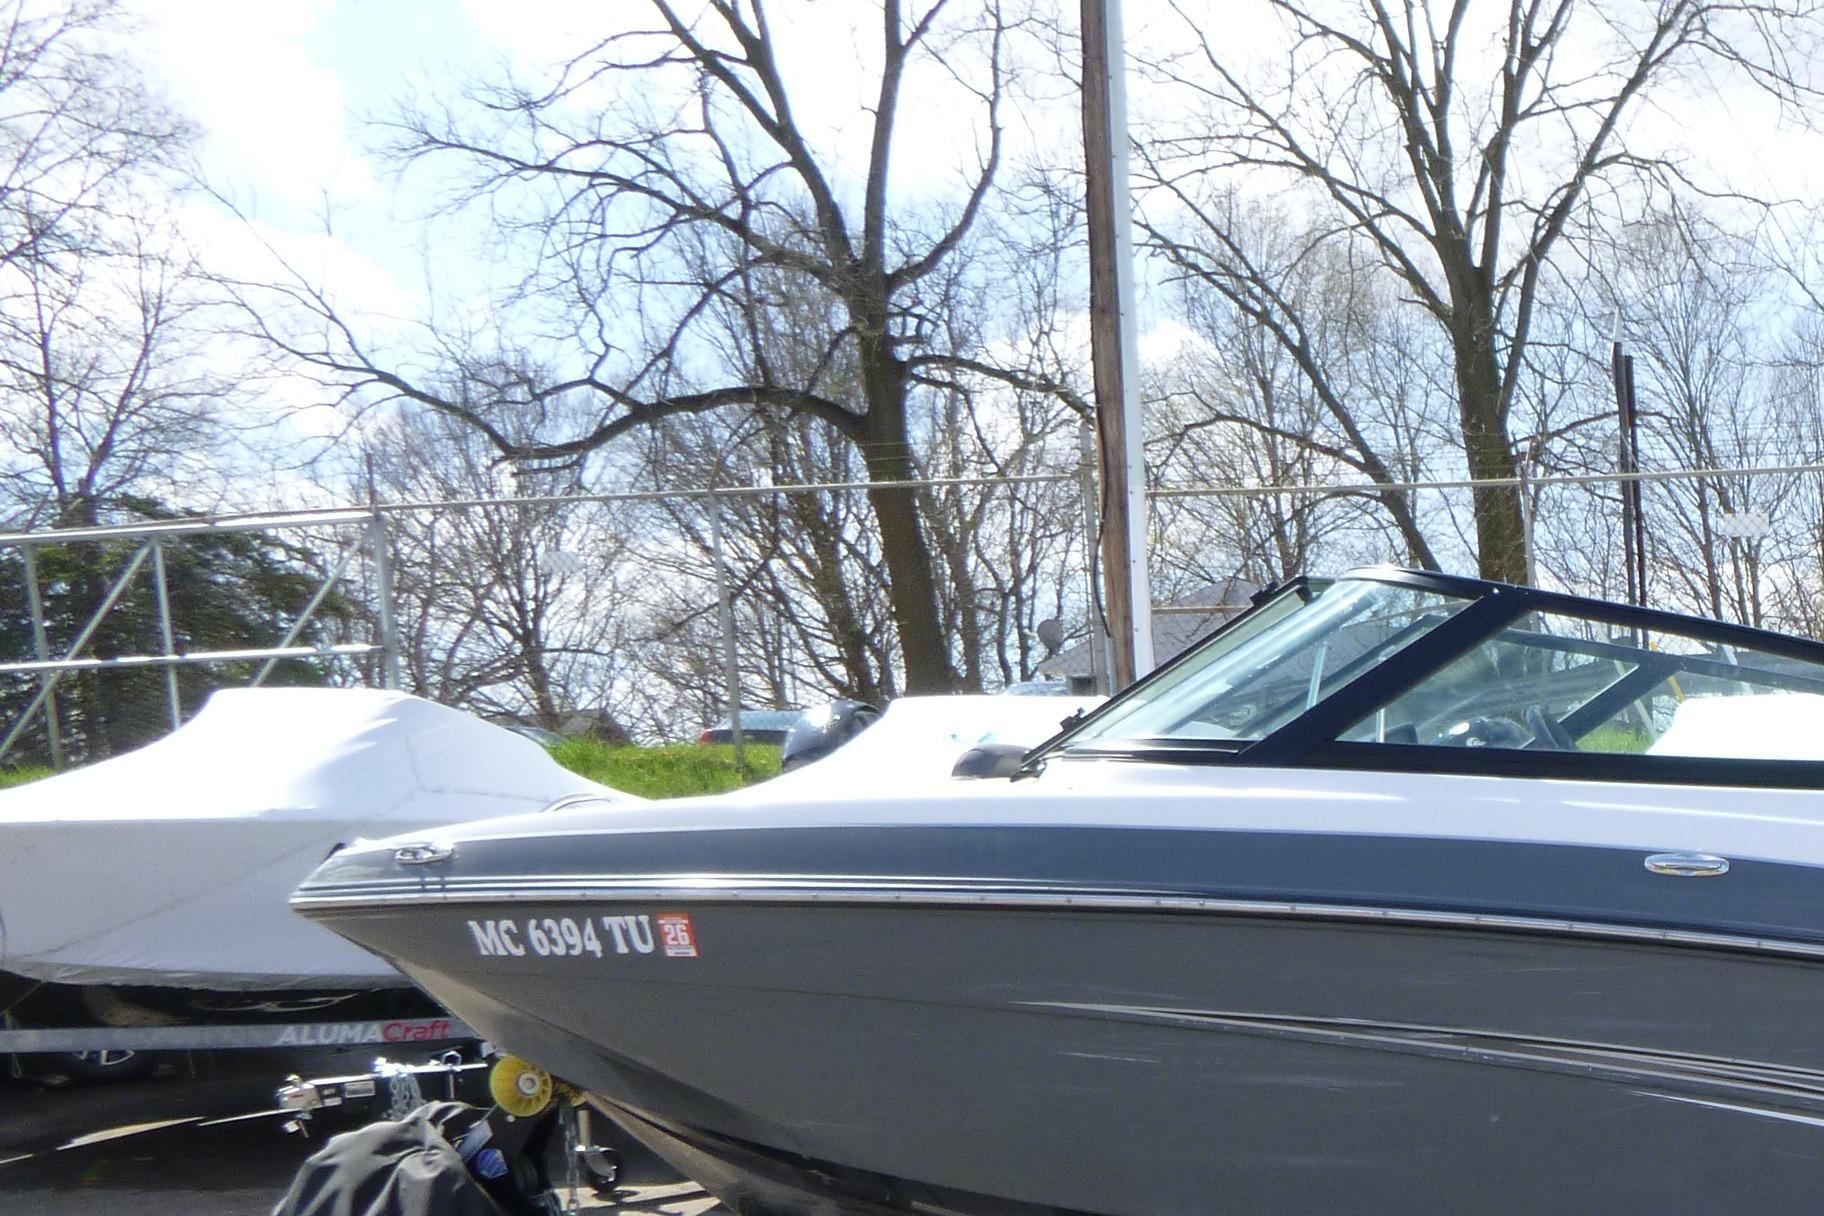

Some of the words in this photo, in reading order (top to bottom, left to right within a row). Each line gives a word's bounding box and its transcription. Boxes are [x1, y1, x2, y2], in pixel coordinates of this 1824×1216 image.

[467, 919, 526, 957] MC
[527, 917, 603, 958] 6394
[602, 914, 655, 955] TU
[663, 923, 691, 946] 26
